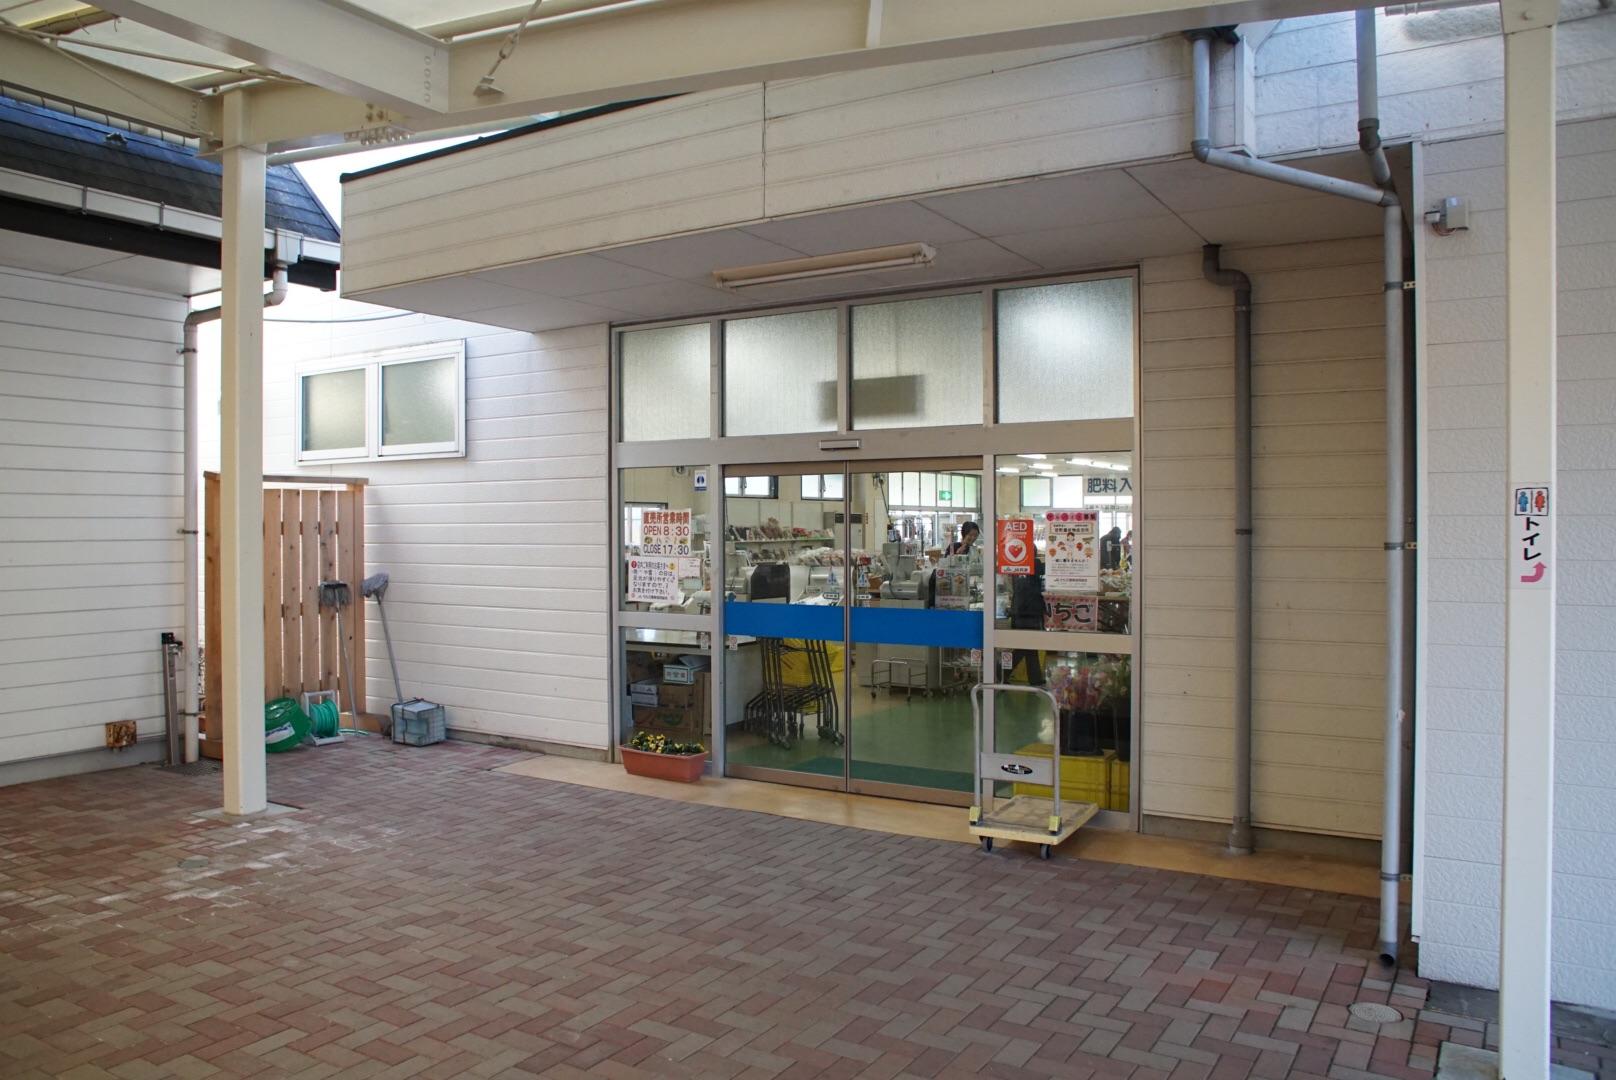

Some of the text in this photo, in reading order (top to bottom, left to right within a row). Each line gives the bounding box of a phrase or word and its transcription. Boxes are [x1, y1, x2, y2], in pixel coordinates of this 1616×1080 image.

[643, 512, 690, 524] 直売所営業時間
[643, 525, 690, 536] OPEN 8:30
[1004, 521, 1027, 531] AED
[1522, 517, 1541, 560] トイレ
[643, 544, 690, 555] CLOSE 17:30
